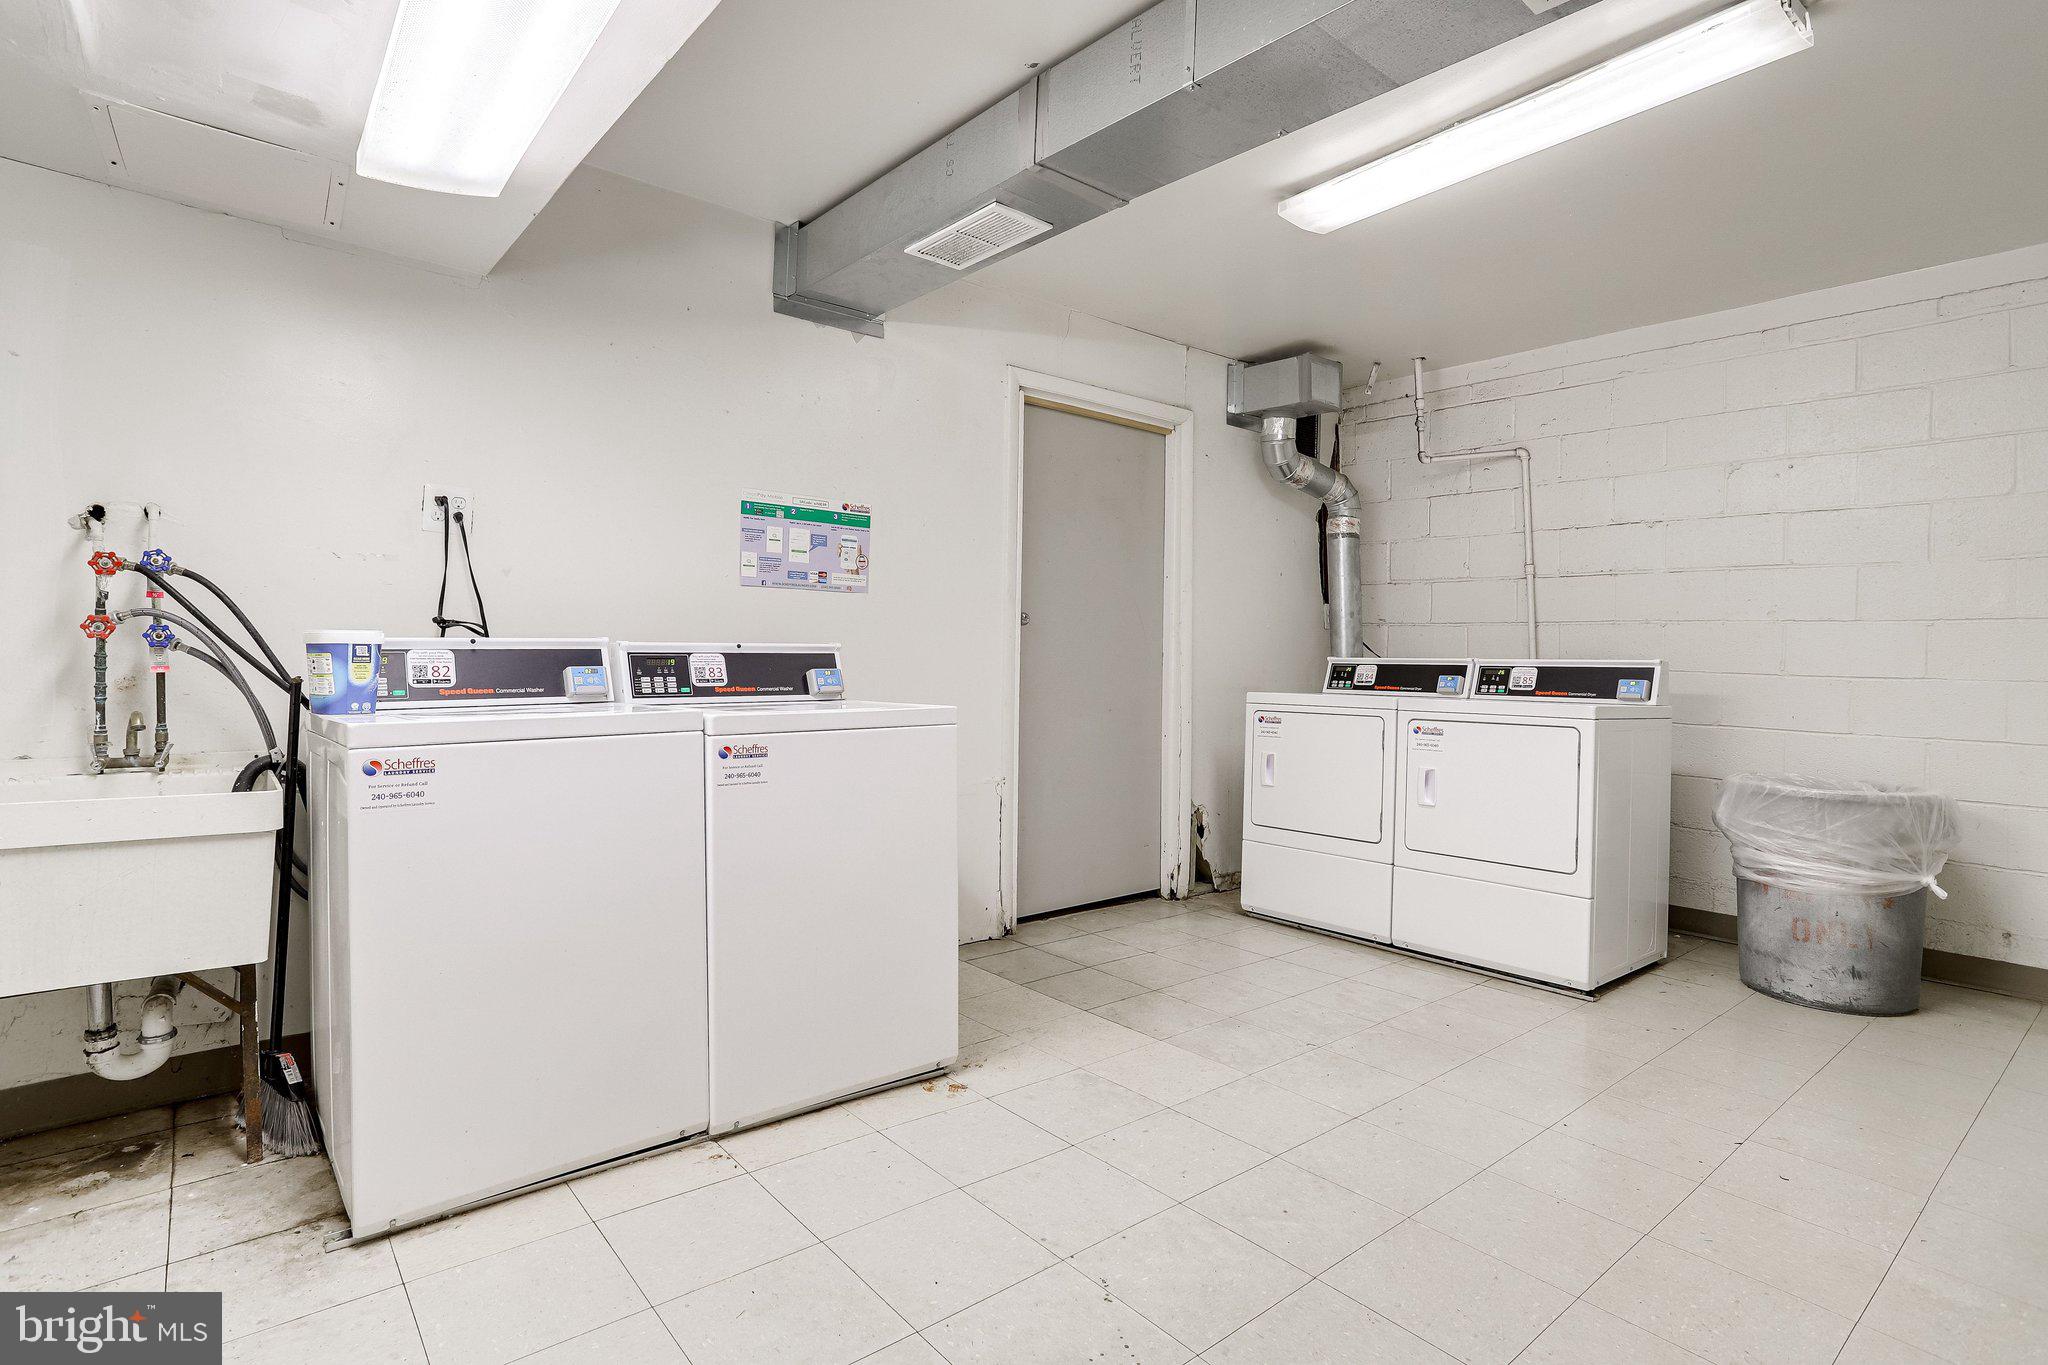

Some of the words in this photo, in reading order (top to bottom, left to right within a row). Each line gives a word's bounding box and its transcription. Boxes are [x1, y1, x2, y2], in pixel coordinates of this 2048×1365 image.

[431, 665, 451, 678] 82
[708, 666, 723, 678] 83
[1522, 676, 1534, 685] 85
[439, 688, 466, 696] Speed
[733, 744, 768, 754] Scheffres
[384, 757, 435, 770] Scheffres
[371, 790, 425, 801] 240-965-6040
